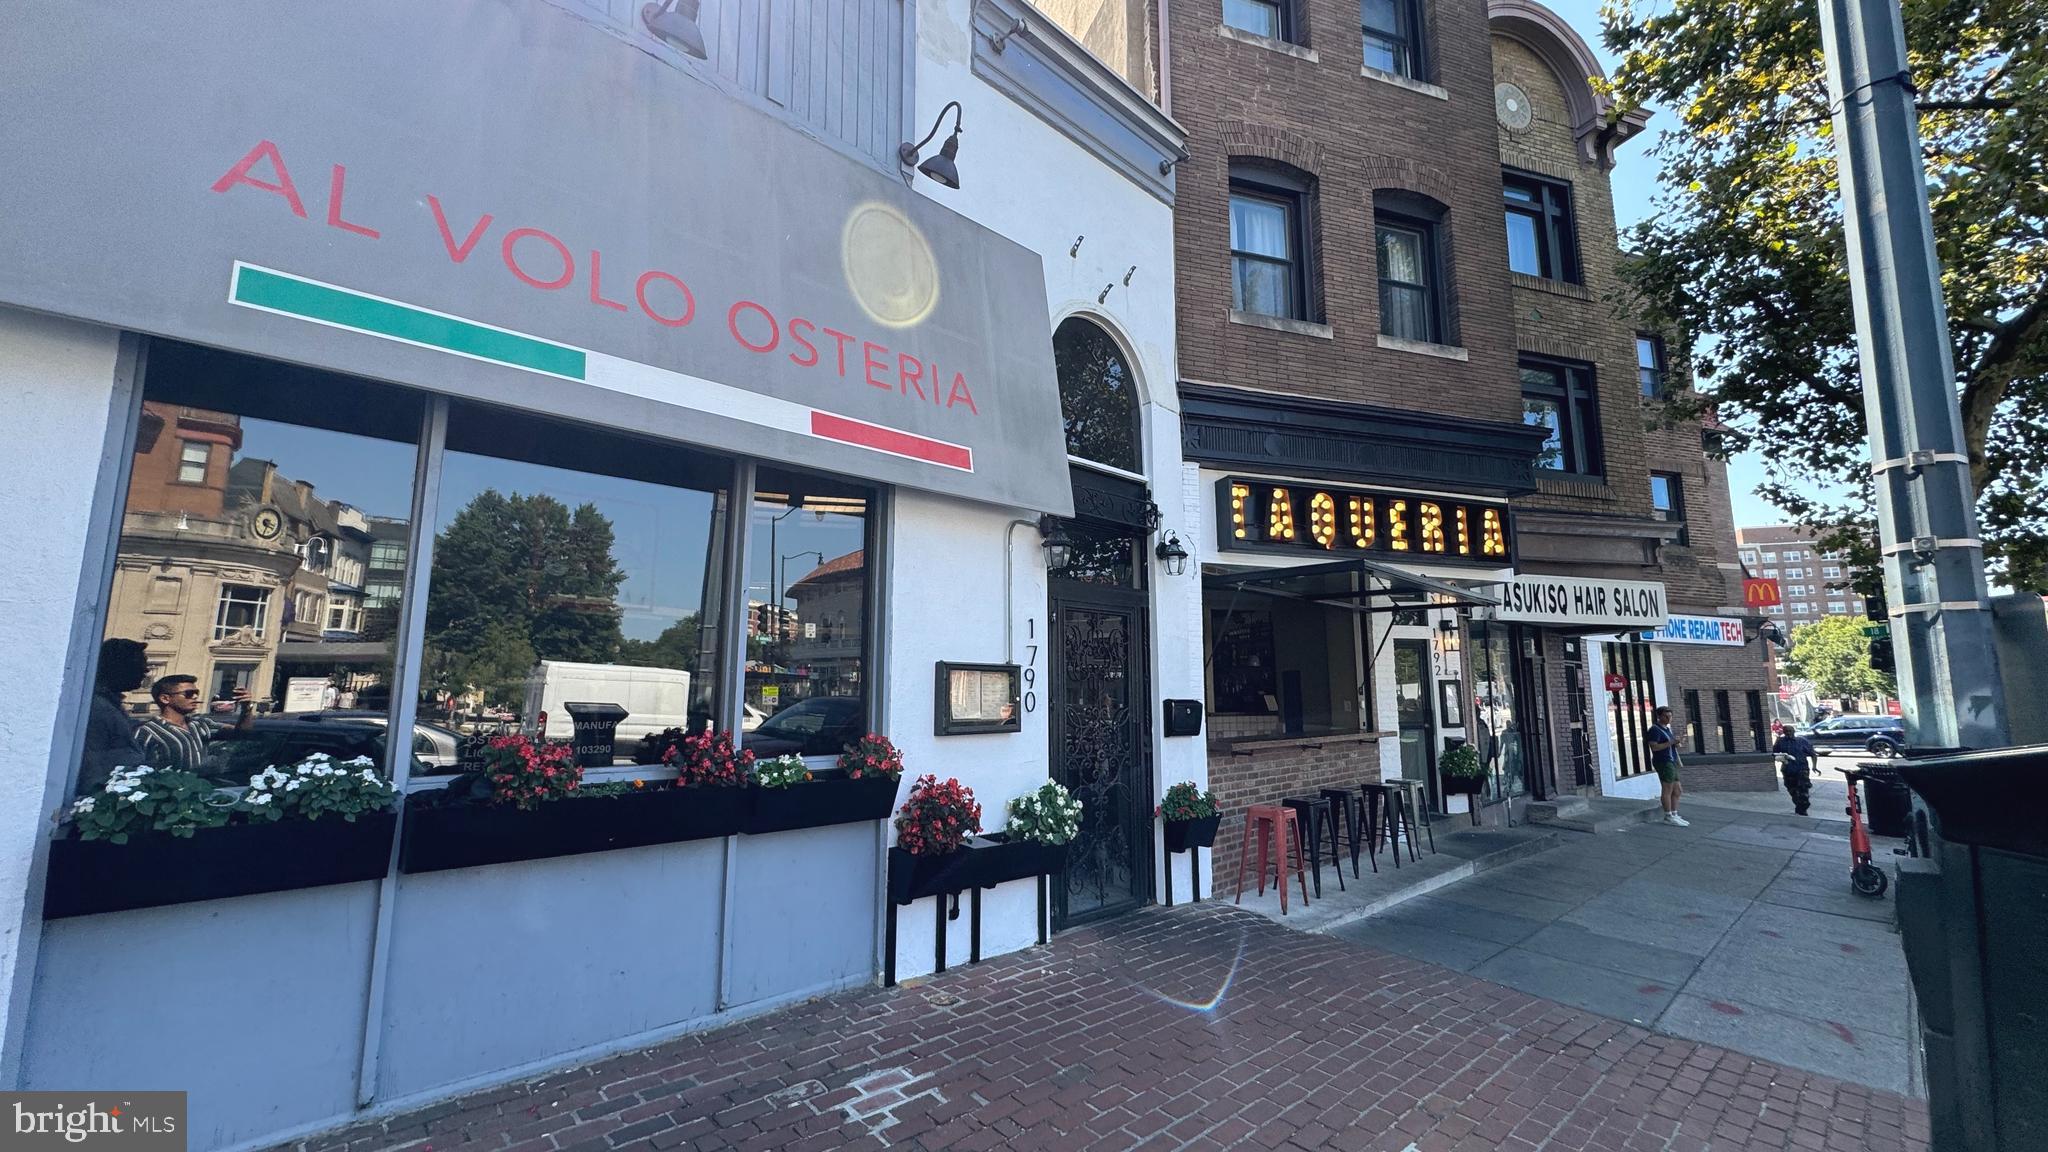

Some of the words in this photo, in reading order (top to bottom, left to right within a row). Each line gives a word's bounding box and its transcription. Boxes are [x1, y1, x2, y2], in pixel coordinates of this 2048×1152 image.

[211, 139, 381, 240] AL
[426, 194, 696, 328] VOLO
[728, 301, 979, 416] OSTERIA
[1231, 484, 1505, 557] TAQUERIA
[1503, 582, 1568, 616] ASUKISQ
[1573, 586, 1607, 616] HAIR
[1614, 587, 1660, 617] SALON
[1024, 618, 1038, 713] 1790
[1432, 628, 1442, 676] 1792
[576, 745, 611, 753] 103290
